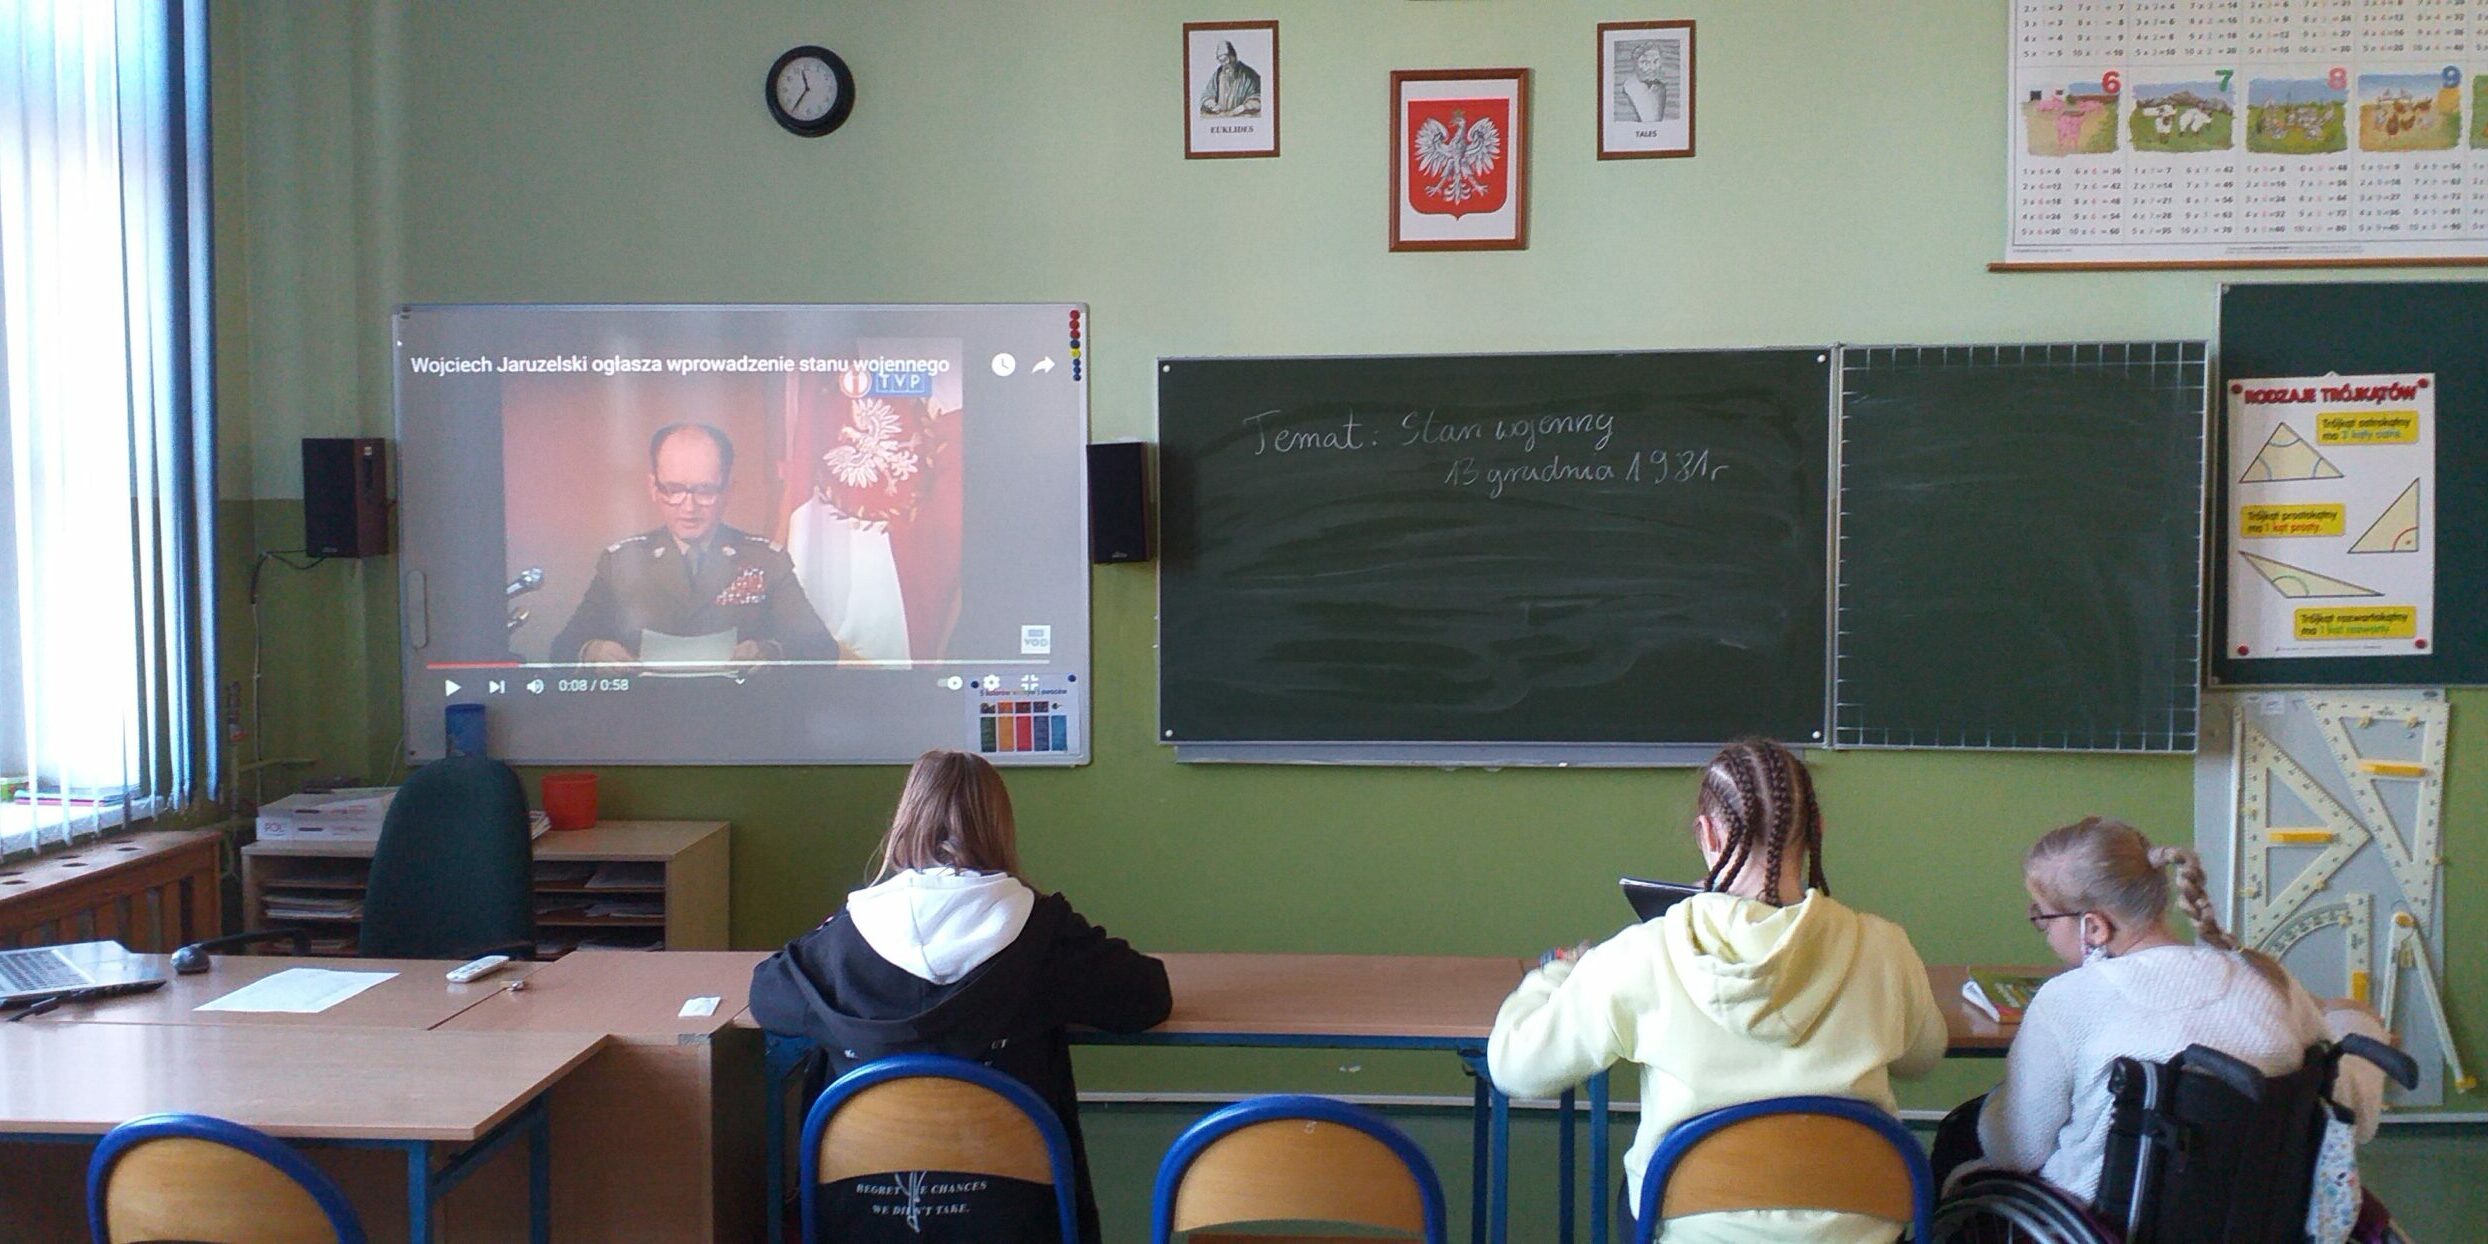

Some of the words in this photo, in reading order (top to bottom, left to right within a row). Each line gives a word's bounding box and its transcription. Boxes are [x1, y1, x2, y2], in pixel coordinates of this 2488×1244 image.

[2102, 70, 2121, 94] 6
[2214, 69, 2234, 92] 7
[2327, 67, 2347, 91] 8
[2441, 64, 2461, 88] 9
[1210, 125, 1255, 134] EUKLIDES
[1635, 130, 1658, 138] TALES
[411, 356, 493, 376] Wojciech
[497, 355, 588, 373] Jaruzelski
[592, 355, 662, 376] ogłasza
[667, 355, 795, 375] wprowadzenie
[800, 357, 849, 373] stanu
[855, 356, 950, 376] wojennego
[879, 374, 921, 390] TVP
[2244, 387, 2317, 405] RODZAJE
[1242, 408, 1379, 455] Temat:
[1402, 408, 1483, 446] Stan
[1495, 413, 1614, 452] wojenny
[1444, 457, 1482, 487] 13
[1487, 455, 1615, 499] grudnia
[559, 679, 588, 691] 0:08
[600, 678, 629, 691] 0:58
[856, 1183, 900, 1195] REGRET
[930, 1181, 988, 1194] CHANCES
[872, 1204, 889, 1214] WE
